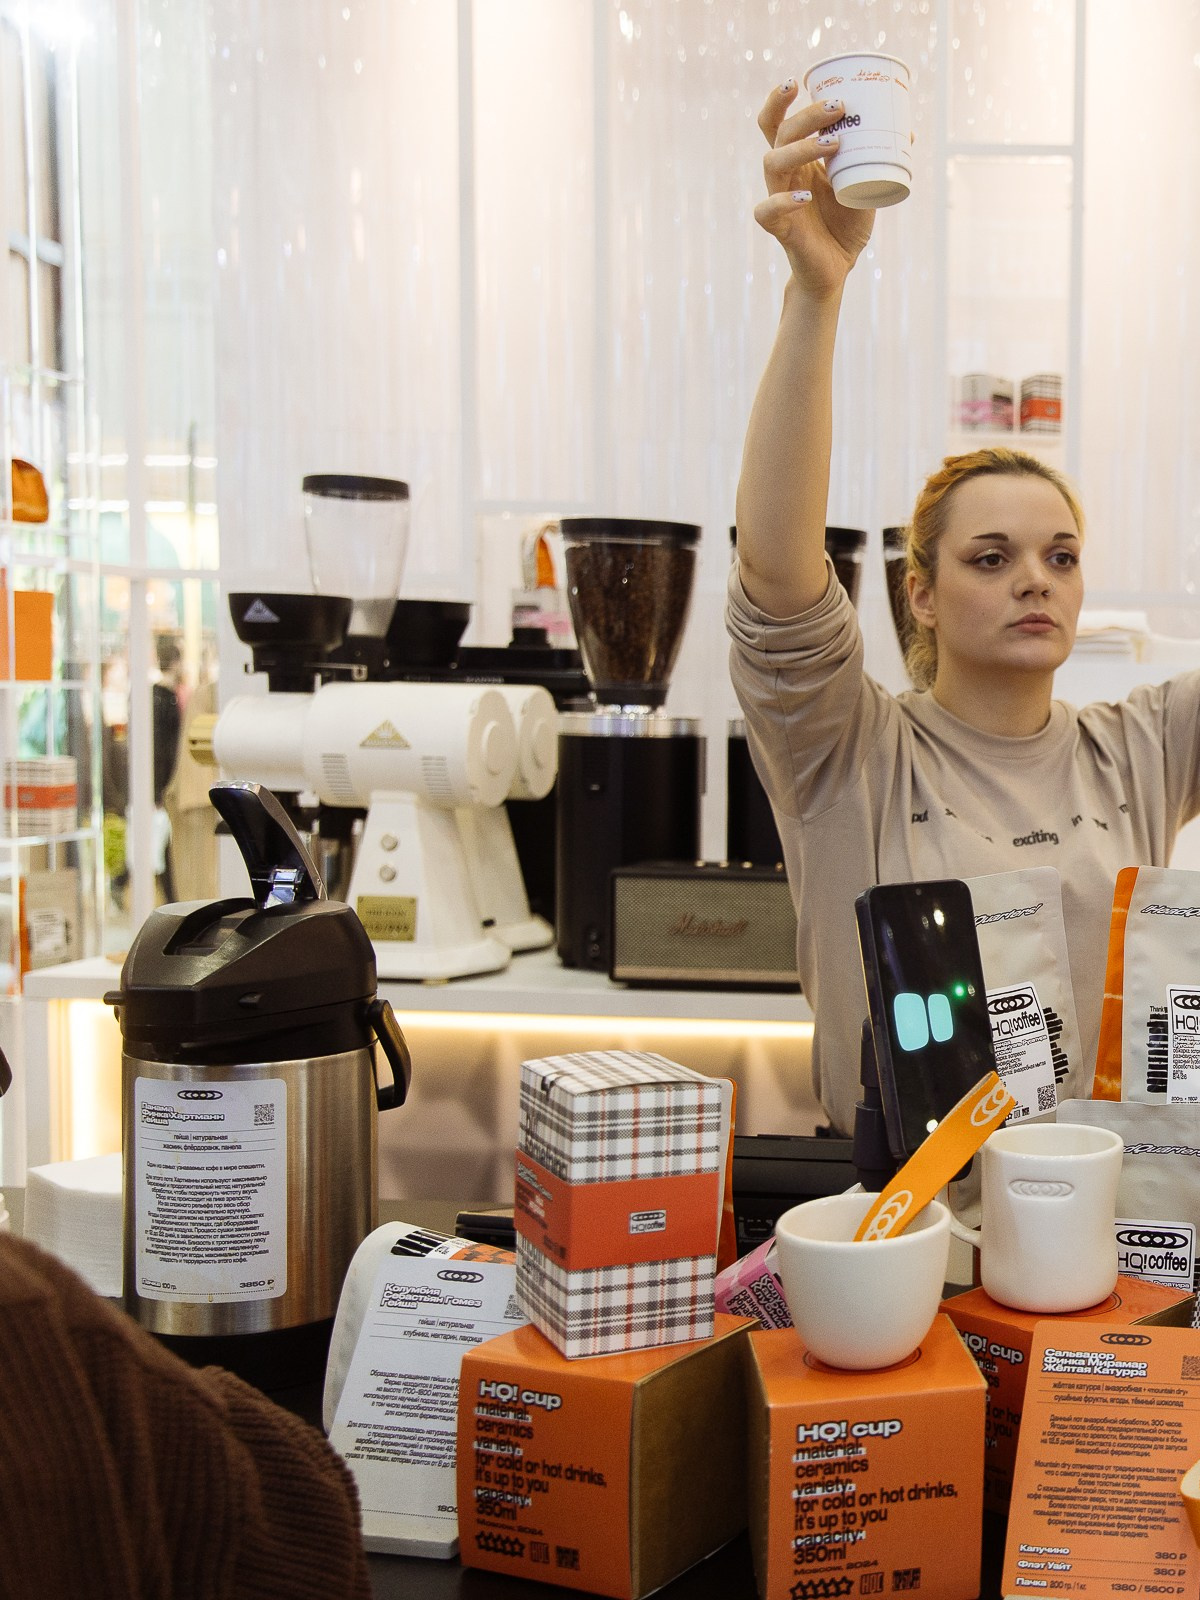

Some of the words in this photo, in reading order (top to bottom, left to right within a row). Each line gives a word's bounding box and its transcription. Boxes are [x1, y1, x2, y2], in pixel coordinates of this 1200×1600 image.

[1013, 829, 1059, 847] exciting
[385, 1283, 441, 1296] Колумбия
[383, 1290, 444, 1304] Себастьян
[444, 1295, 482, 1308] Гомез
[439, 1320, 474, 1330] натуральная
[403, 1329, 430, 1339] клубника,
[430, 1332, 458, 1341] нектарин,
[989, 1343, 1024, 1364] cup
[1044, 1348, 1115, 1361] Сальвадор
[1042, 1363, 1092, 1374] Жёлтая
[1093, 1366, 1147, 1378] Катурра
[1043, 1356, 1086, 1366] Финка
[1088, 1358, 1148, 1370] Мирамар
[478, 1379, 519, 1404] HQ!
[521, 1389, 562, 1410] cup
[1076, 1383, 1101, 1391] катурра
[476, 1418, 534, 1439] ceramics
[797, 1420, 848, 1443] HQ!
[851, 1419, 902, 1438] cup
[475, 1452, 494, 1466] for
[496, 1454, 523, 1472] cold
[525, 1460, 540, 1474] or
[542, 1459, 563, 1479] hot
[795, 1457, 869, 1479] ceramics
[493, 1472, 509, 1488] up
[512, 1472, 524, 1488] to
[526, 1477, 549, 1494] you
[795, 1497, 819, 1513] for
[822, 1492, 855, 1510] cold
[859, 1492, 877, 1506] or
[880, 1486, 904, 1504] hot
[907, 1481, 958, 1501] drinks,
[819, 1514, 838, 1529] up
[842, 1510, 856, 1526] to
[860, 1508, 887, 1527] you
[794, 1545, 846, 1565] 350ml
[1019, 1544, 1070, 1556] Капучино
[1155, 1552, 1177, 1560] 380
[1017, 1560, 1046, 1569] Флэт
[1047, 1561, 1072, 1571] Уайт
[1153, 1568, 1176, 1576] 380
[1015, 1577, 1048, 1588] Пачка
[1111, 1583, 1136, 1592] 1380
